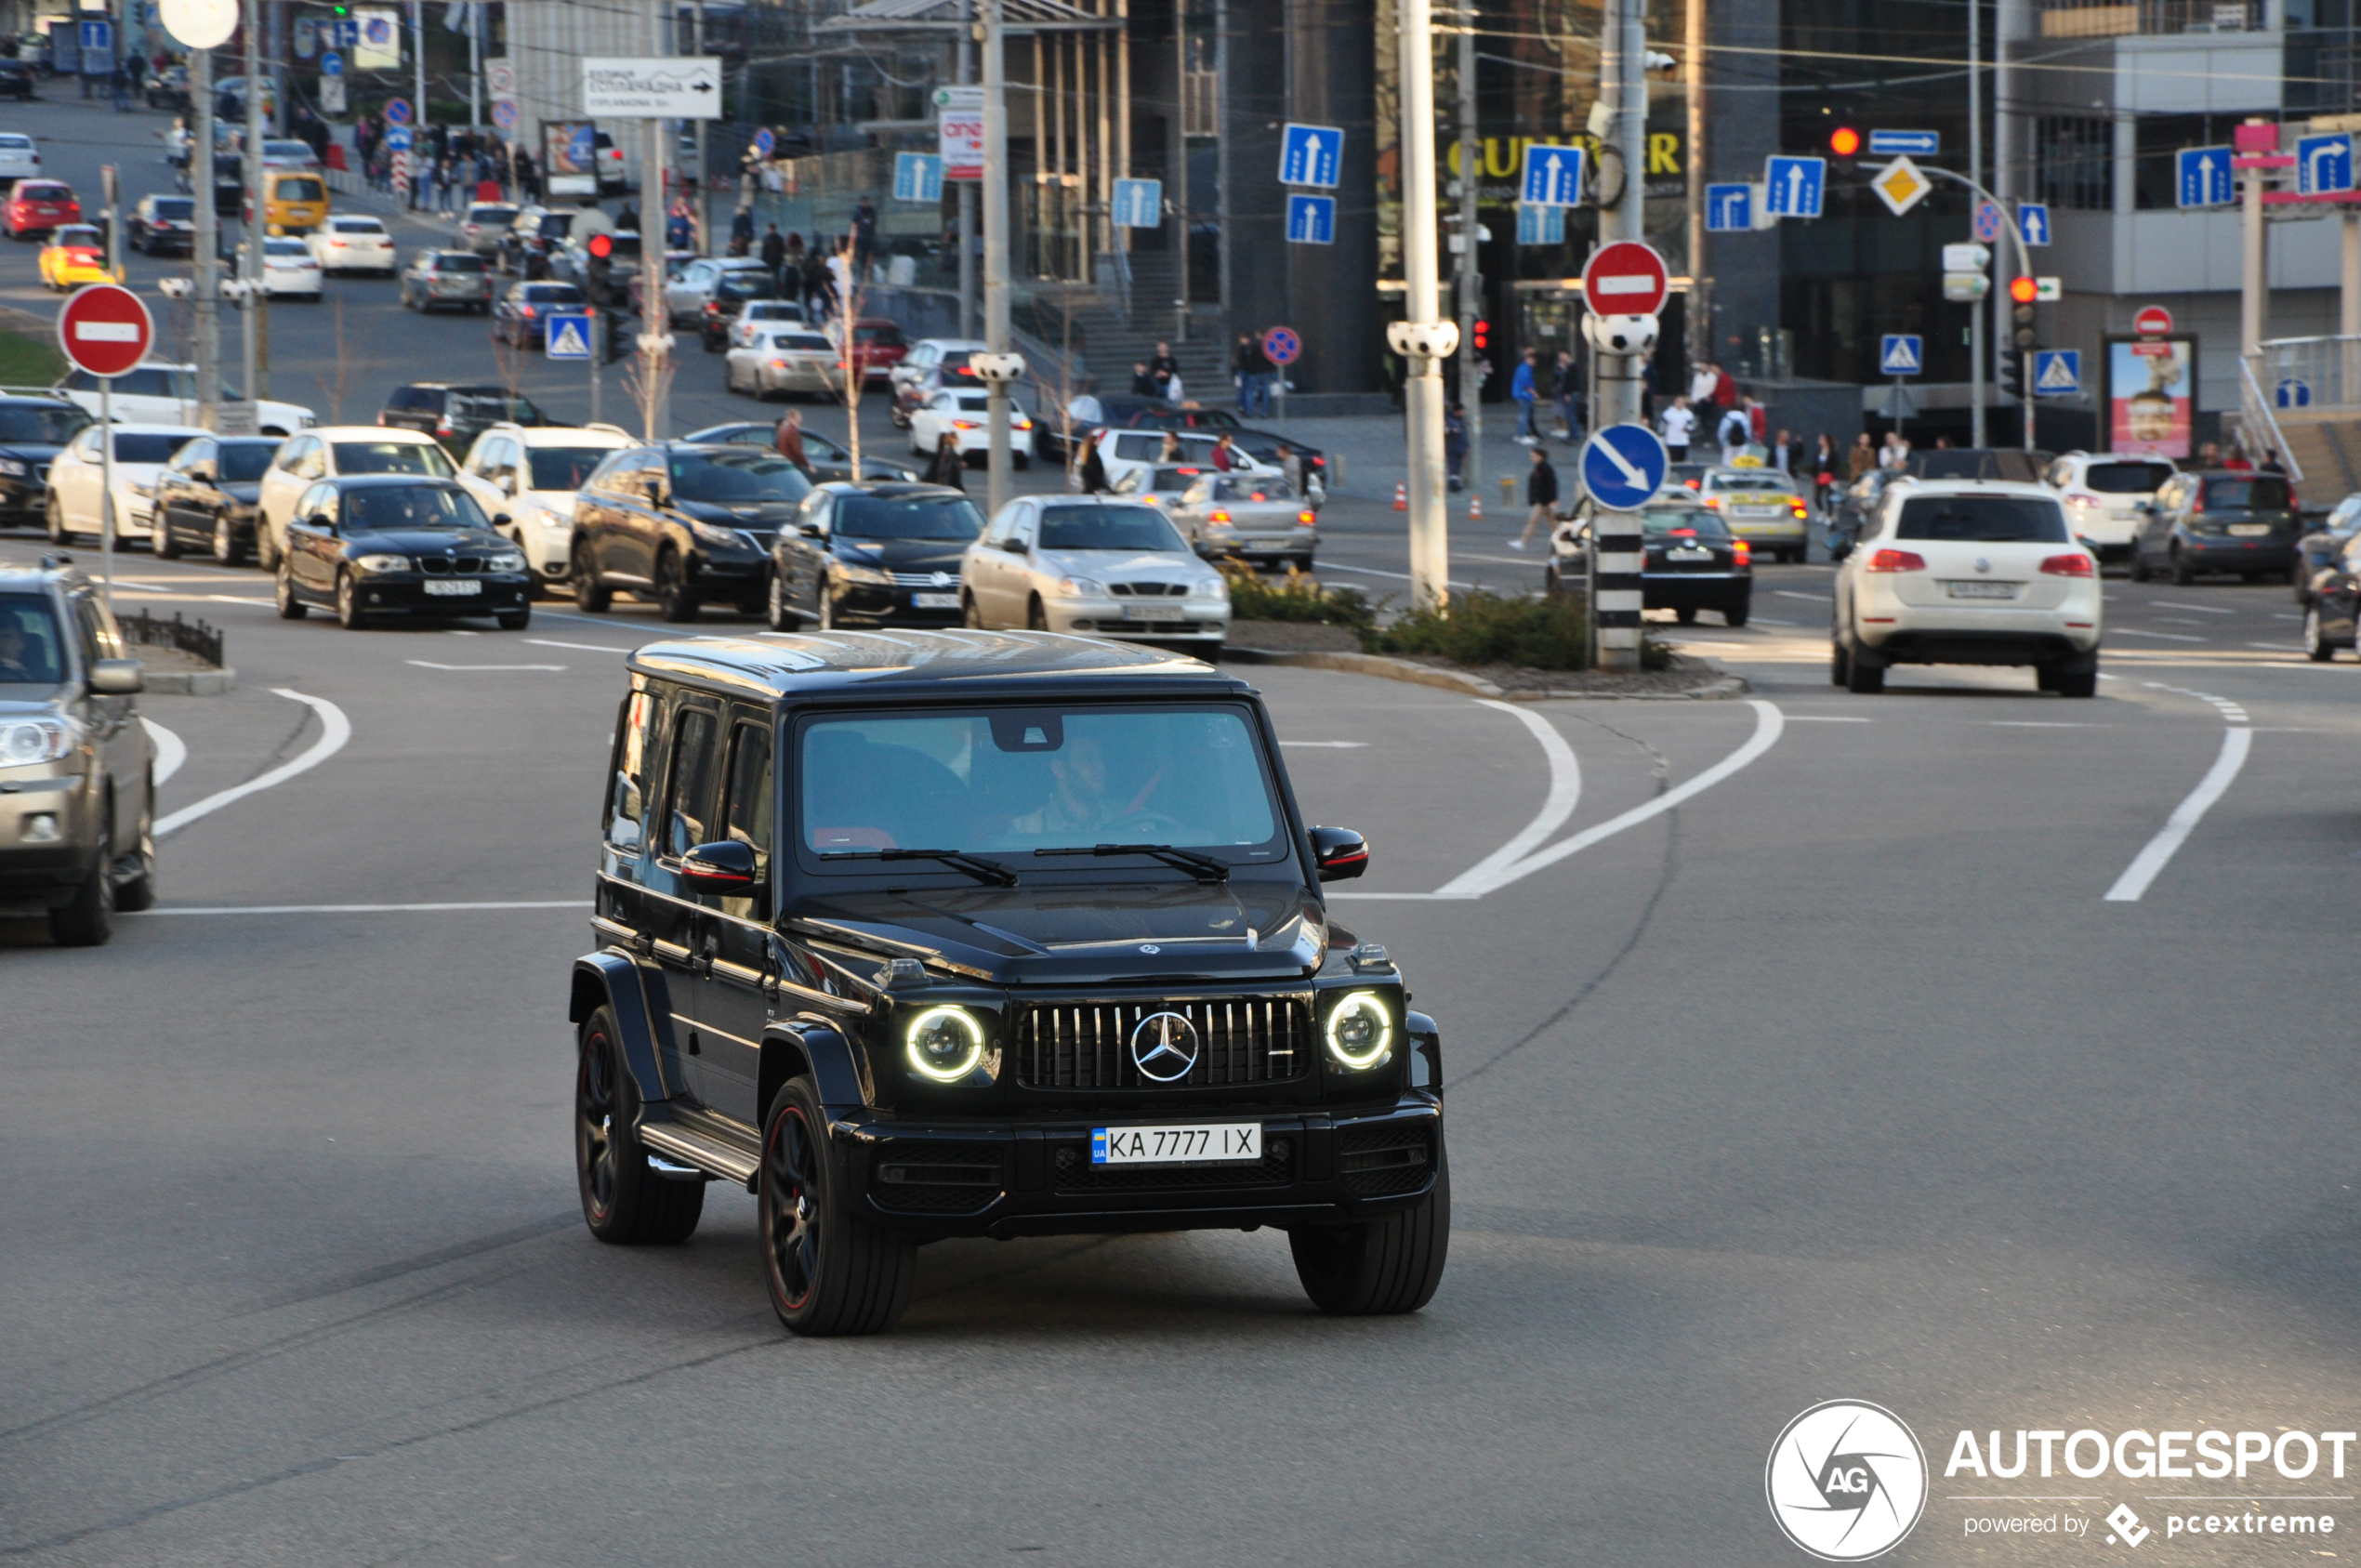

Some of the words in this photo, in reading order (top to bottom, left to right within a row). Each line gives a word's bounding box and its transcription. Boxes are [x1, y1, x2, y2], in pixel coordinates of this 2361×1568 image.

[1110, 1132, 1145, 1157] KA
[1153, 1129, 1210, 1156] 7777
[1223, 1128, 1253, 1154] IX
[1094, 1149, 1106, 1158] UA
